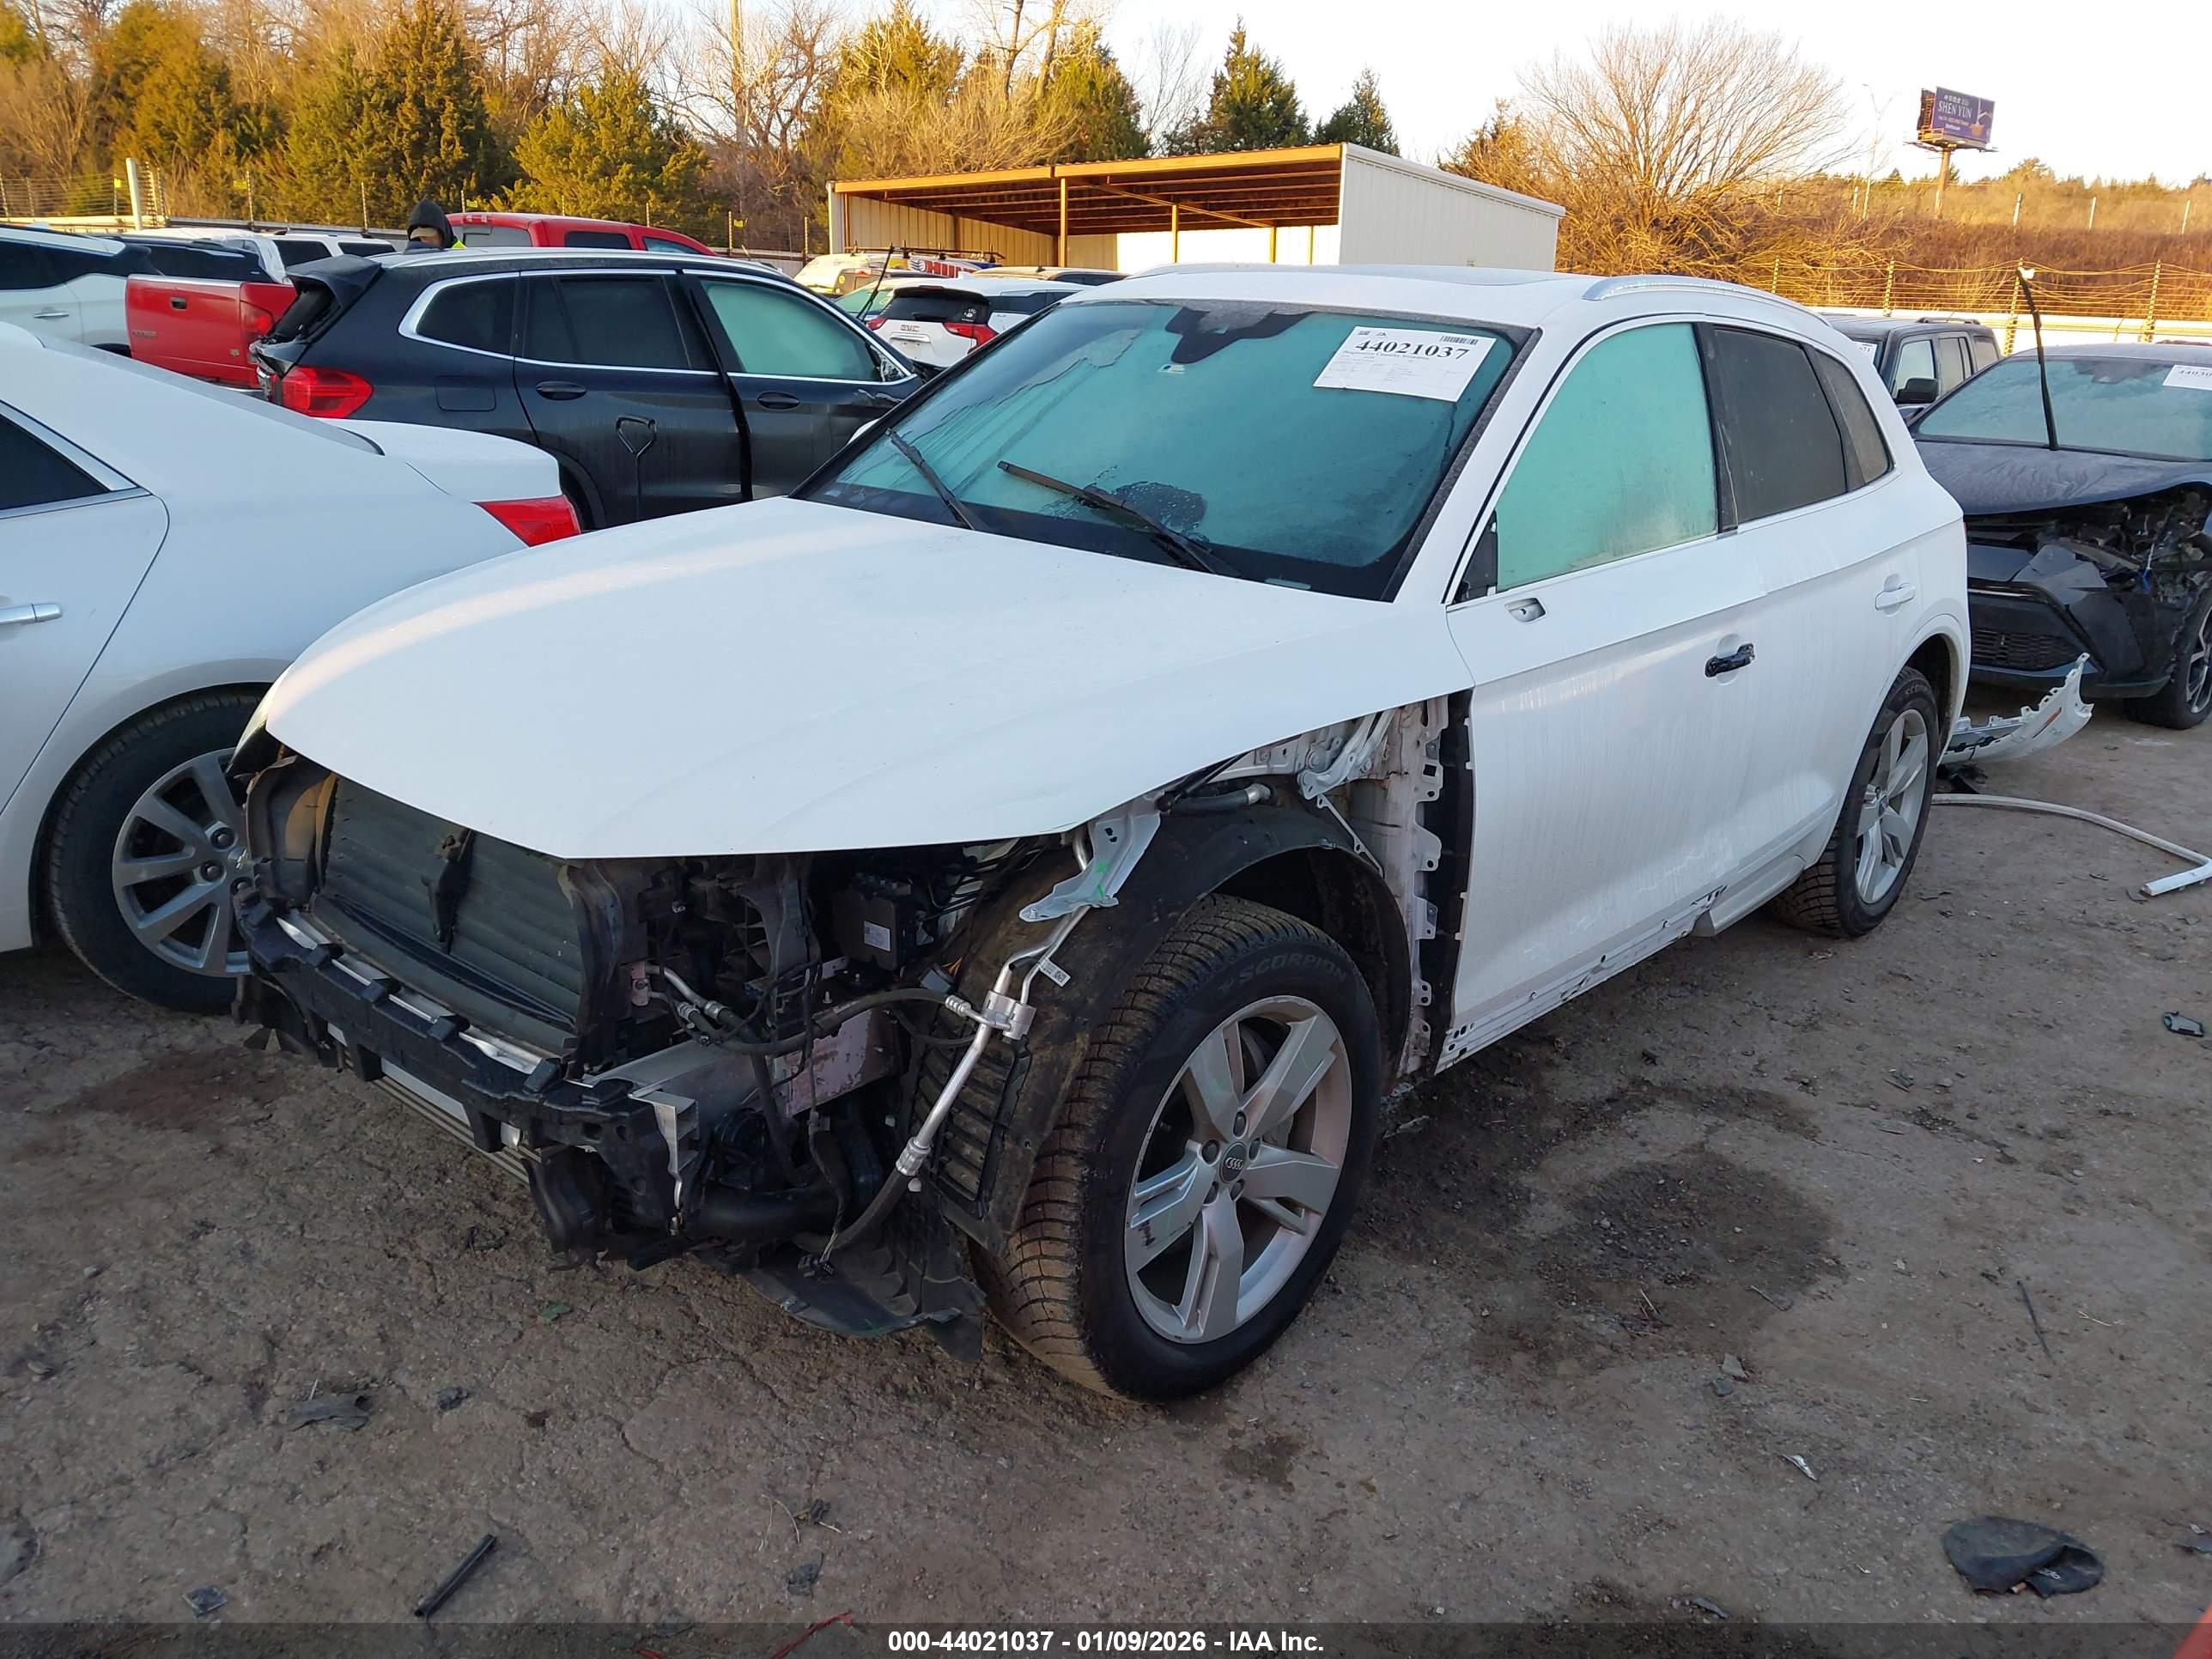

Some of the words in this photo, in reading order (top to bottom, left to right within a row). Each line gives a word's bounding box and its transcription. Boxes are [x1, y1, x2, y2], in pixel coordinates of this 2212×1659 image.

[1938, 100, 1956, 116] SHEN
[1958, 105, 1972, 118] YUN
[1355, 340, 1470, 360] 44021037
[1238, 953, 1347, 983] SCORPION
